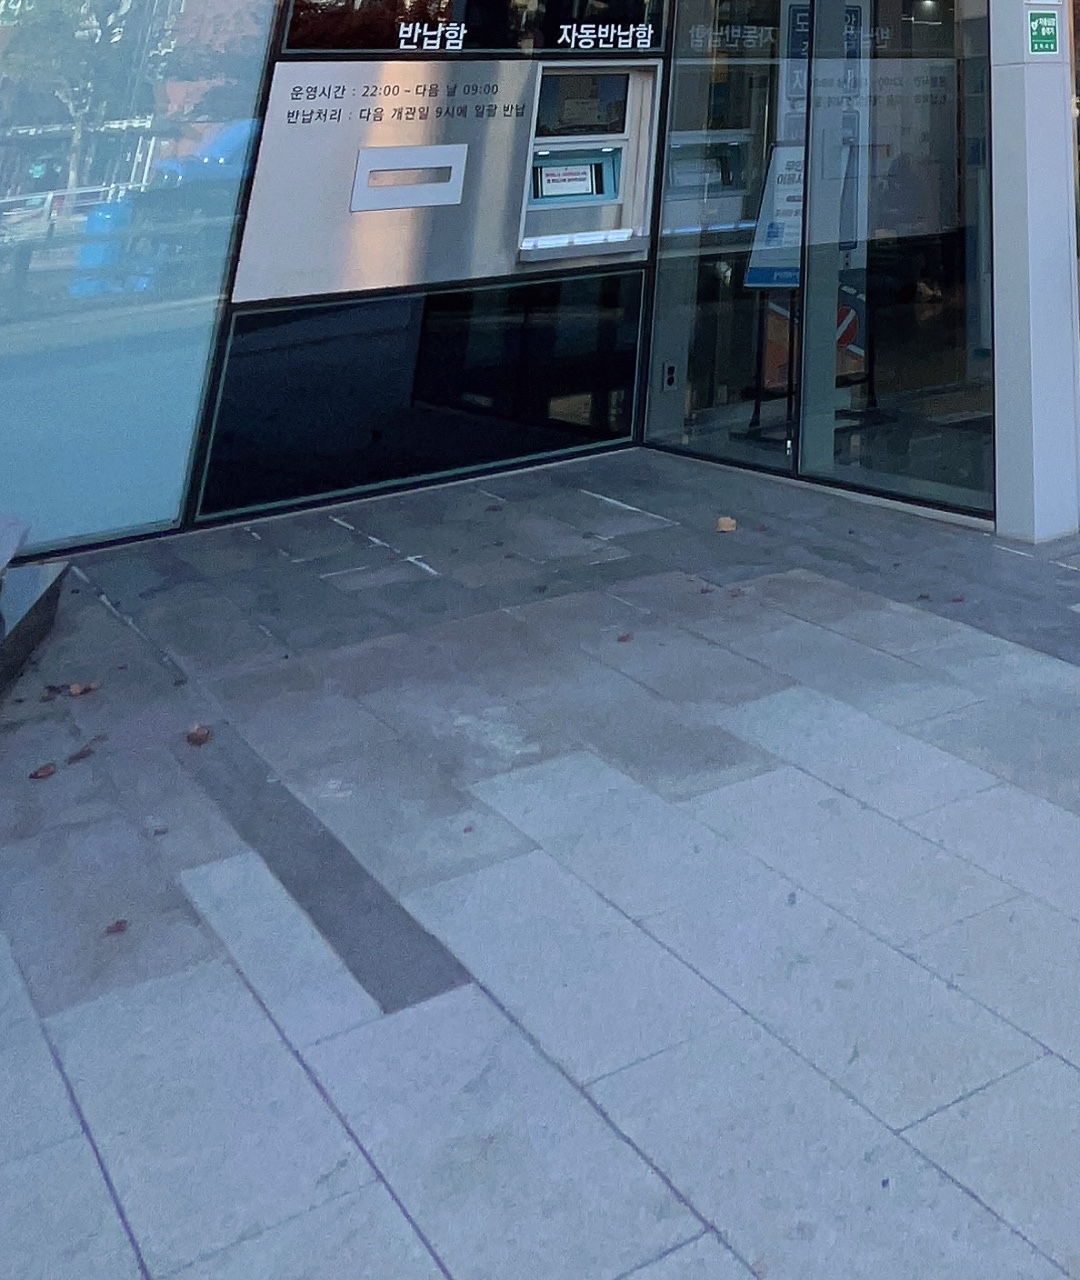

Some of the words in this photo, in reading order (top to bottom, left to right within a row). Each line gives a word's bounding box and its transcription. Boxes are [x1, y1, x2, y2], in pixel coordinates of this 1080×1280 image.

[398, 21, 468, 50] 반납함
[557, 23, 654, 49] 자동반납함
[290, 85, 346, 100] 운영시간
[361, 85, 400, 97] 22:00
[415, 83, 439, 97] 다음
[463, 83, 499, 96] 09:00
[286, 108, 342, 124] 반납처리
[359, 107, 385, 122] 다음
[391, 105, 429, 120] 개관일
[435, 105, 467, 119] 9시에
[475, 104, 498, 118] 일괄
[502, 102, 526, 118] 반납
